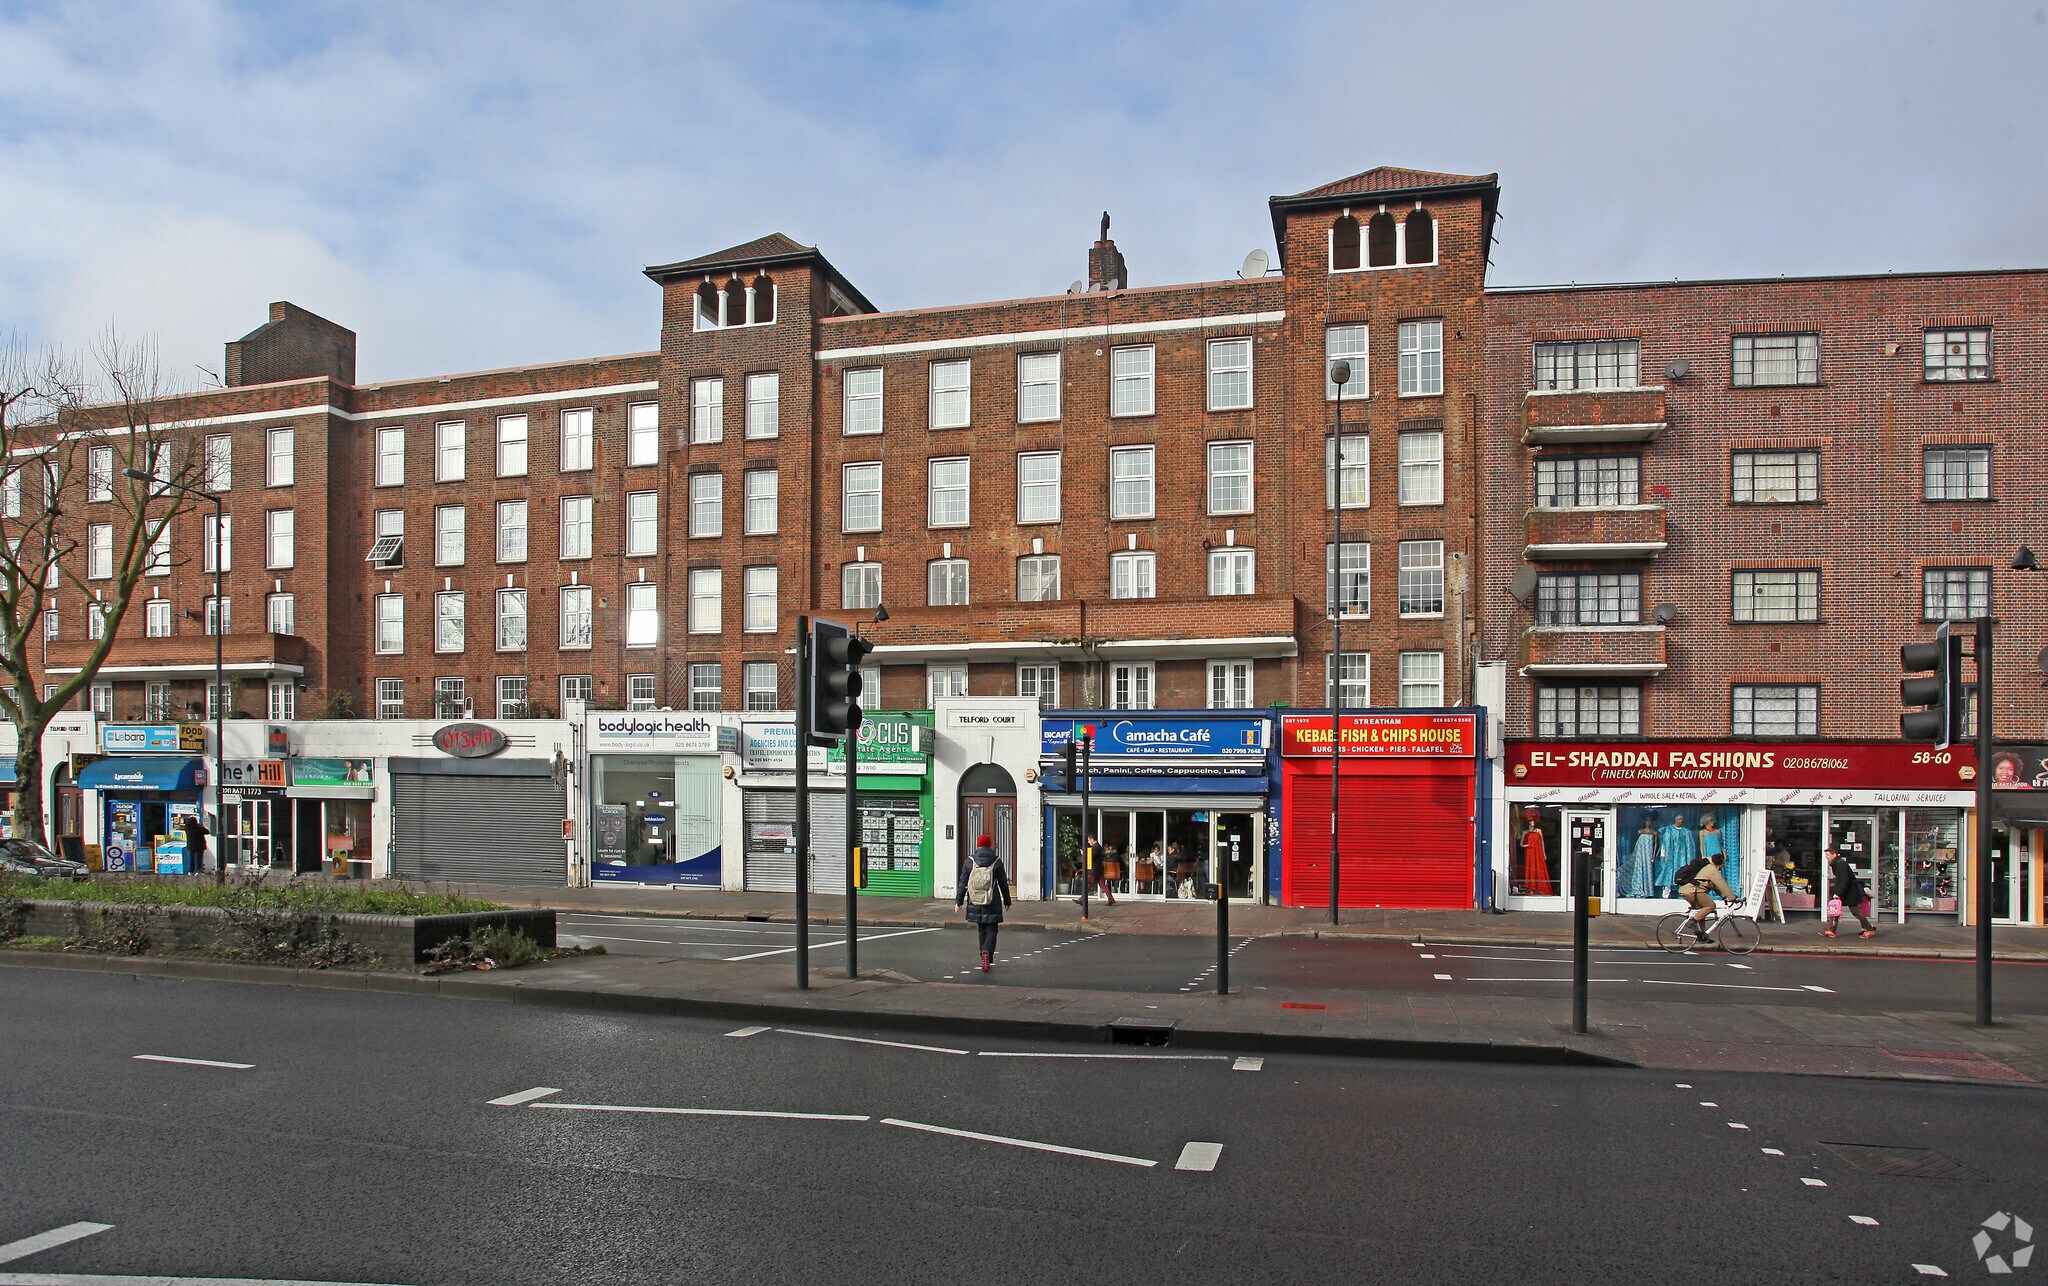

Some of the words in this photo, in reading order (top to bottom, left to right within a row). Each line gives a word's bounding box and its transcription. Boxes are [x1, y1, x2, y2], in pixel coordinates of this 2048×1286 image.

[958, 716, 990, 724] TELFORD
[992, 716, 1016, 724] COURT
[181, 727, 203, 735] FOOD
[599, 717, 662, 735] bodylogic
[664, 717, 711, 732] health
[115, 732, 146, 742] Lebara
[1180, 728, 1211, 742] Café
[1341, 729, 1368, 743] FISH
[1370, 729, 1379, 742] &
[1381, 728, 1417, 743] CHIPS
[1419, 728, 1462, 743] HOUSE
[749, 739, 777, 748] AGENCIES
[777, 739, 789, 748] AND
[879, 745, 906, 754] Agent
[1530, 751, 1659, 768] EL-SHADDAI
[1669, 751, 1775, 768] FASHIONS
[1782, 757, 1849, 769] 02086781062
[1911, 752, 1952, 764] 58-60
[113, 772, 144, 781] Lycamobile
[223, 763, 243, 780] he
[258, 763, 281, 781] Hill
[1104, 767, 1132, 775] Panini,
[1134, 767, 1165, 775] Coffee,
[1167, 767, 1221, 776] Cappuccino,
[1637, 769, 1671, 779] FASHION
[1673, 769, 1713, 780] SOLUTION
[1577, 789, 1600, 803] ORGANZA
[1809, 791, 1824, 805] SHOE
[1840, 792, 1853, 804] BAGS
[1873, 793, 1910, 802] TAILORING
[1916, 793, 1947, 802] SERVICES
